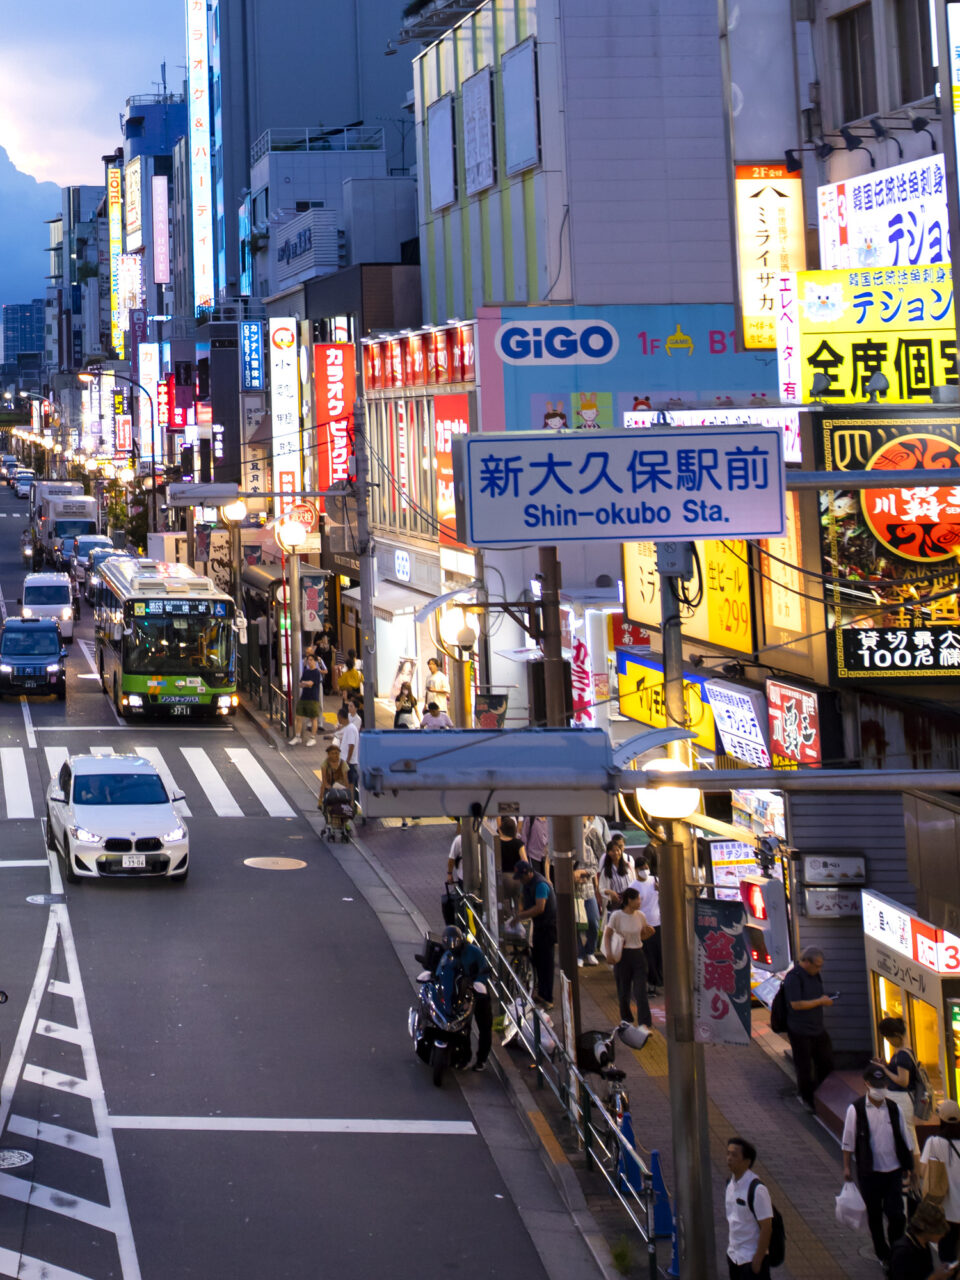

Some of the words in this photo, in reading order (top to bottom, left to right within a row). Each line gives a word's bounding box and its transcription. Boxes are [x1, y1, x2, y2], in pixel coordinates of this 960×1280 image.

[110, 171, 120, 206] HOTEL
[887, 204, 951, 266] テジョ
[848, 267, 952, 287] 韓国伝統活魚刺身
[853, 287, 953, 324] テジョン
[500, 325, 613, 360] GiGO
[637, 331, 661, 356] 1F
[779, 278, 797, 400] エレベーター有
[326, 348, 345, 416] カラオケ
[480, 446, 770, 499] 新大久保駅前
[523, 501, 671, 529] Shin-okubo
[682, 499, 730, 523] Sta.
